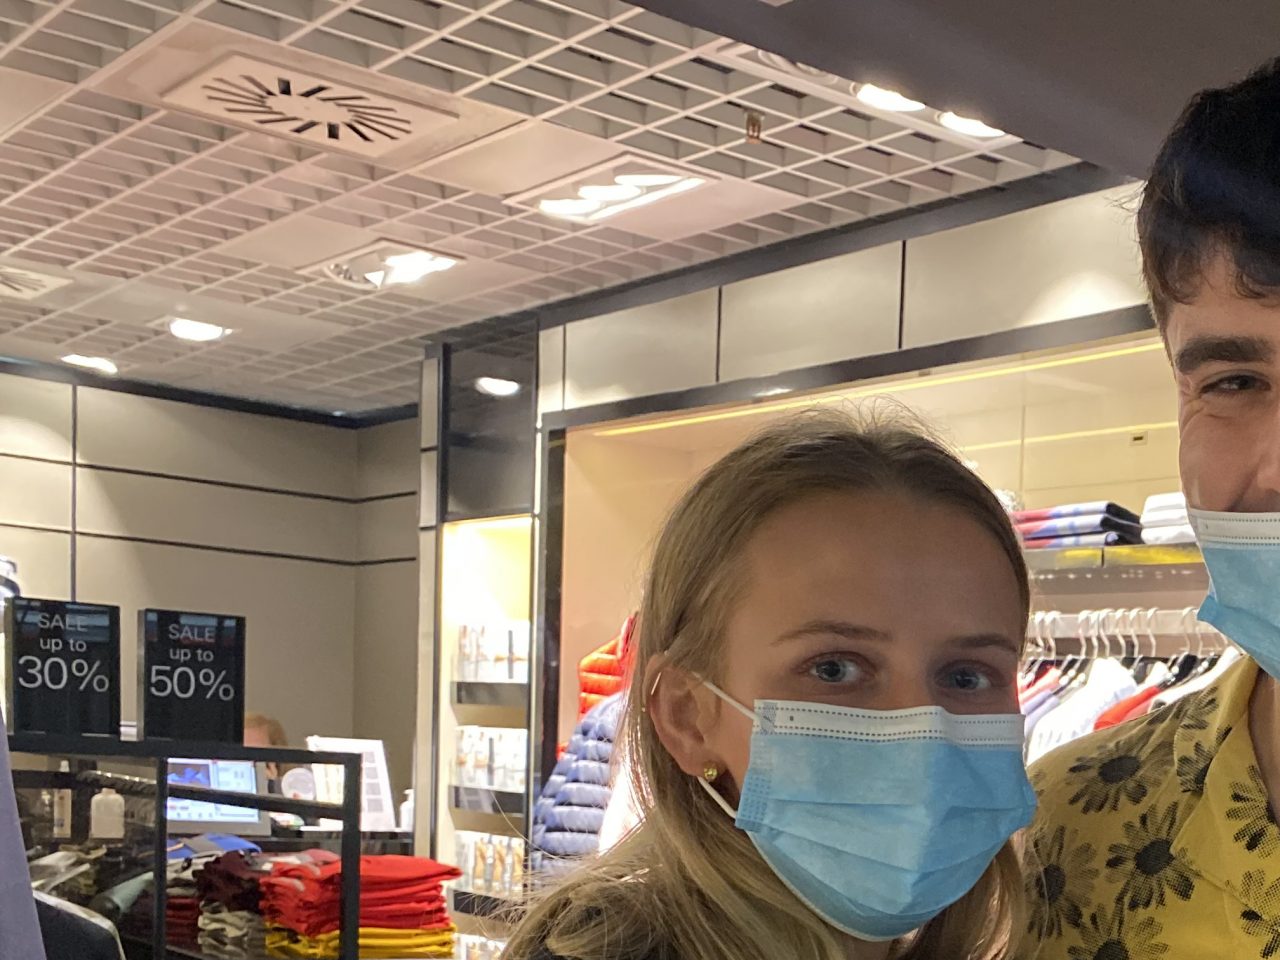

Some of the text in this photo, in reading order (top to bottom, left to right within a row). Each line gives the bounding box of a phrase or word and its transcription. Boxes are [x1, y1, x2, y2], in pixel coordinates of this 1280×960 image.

[37, 613, 88, 632] SALE
[168, 623, 216, 642] SALE
[40, 638, 87, 652] up to
[169, 648, 214, 663] up to
[18, 655, 109, 692] 30%
[150, 665, 234, 701] 50%
